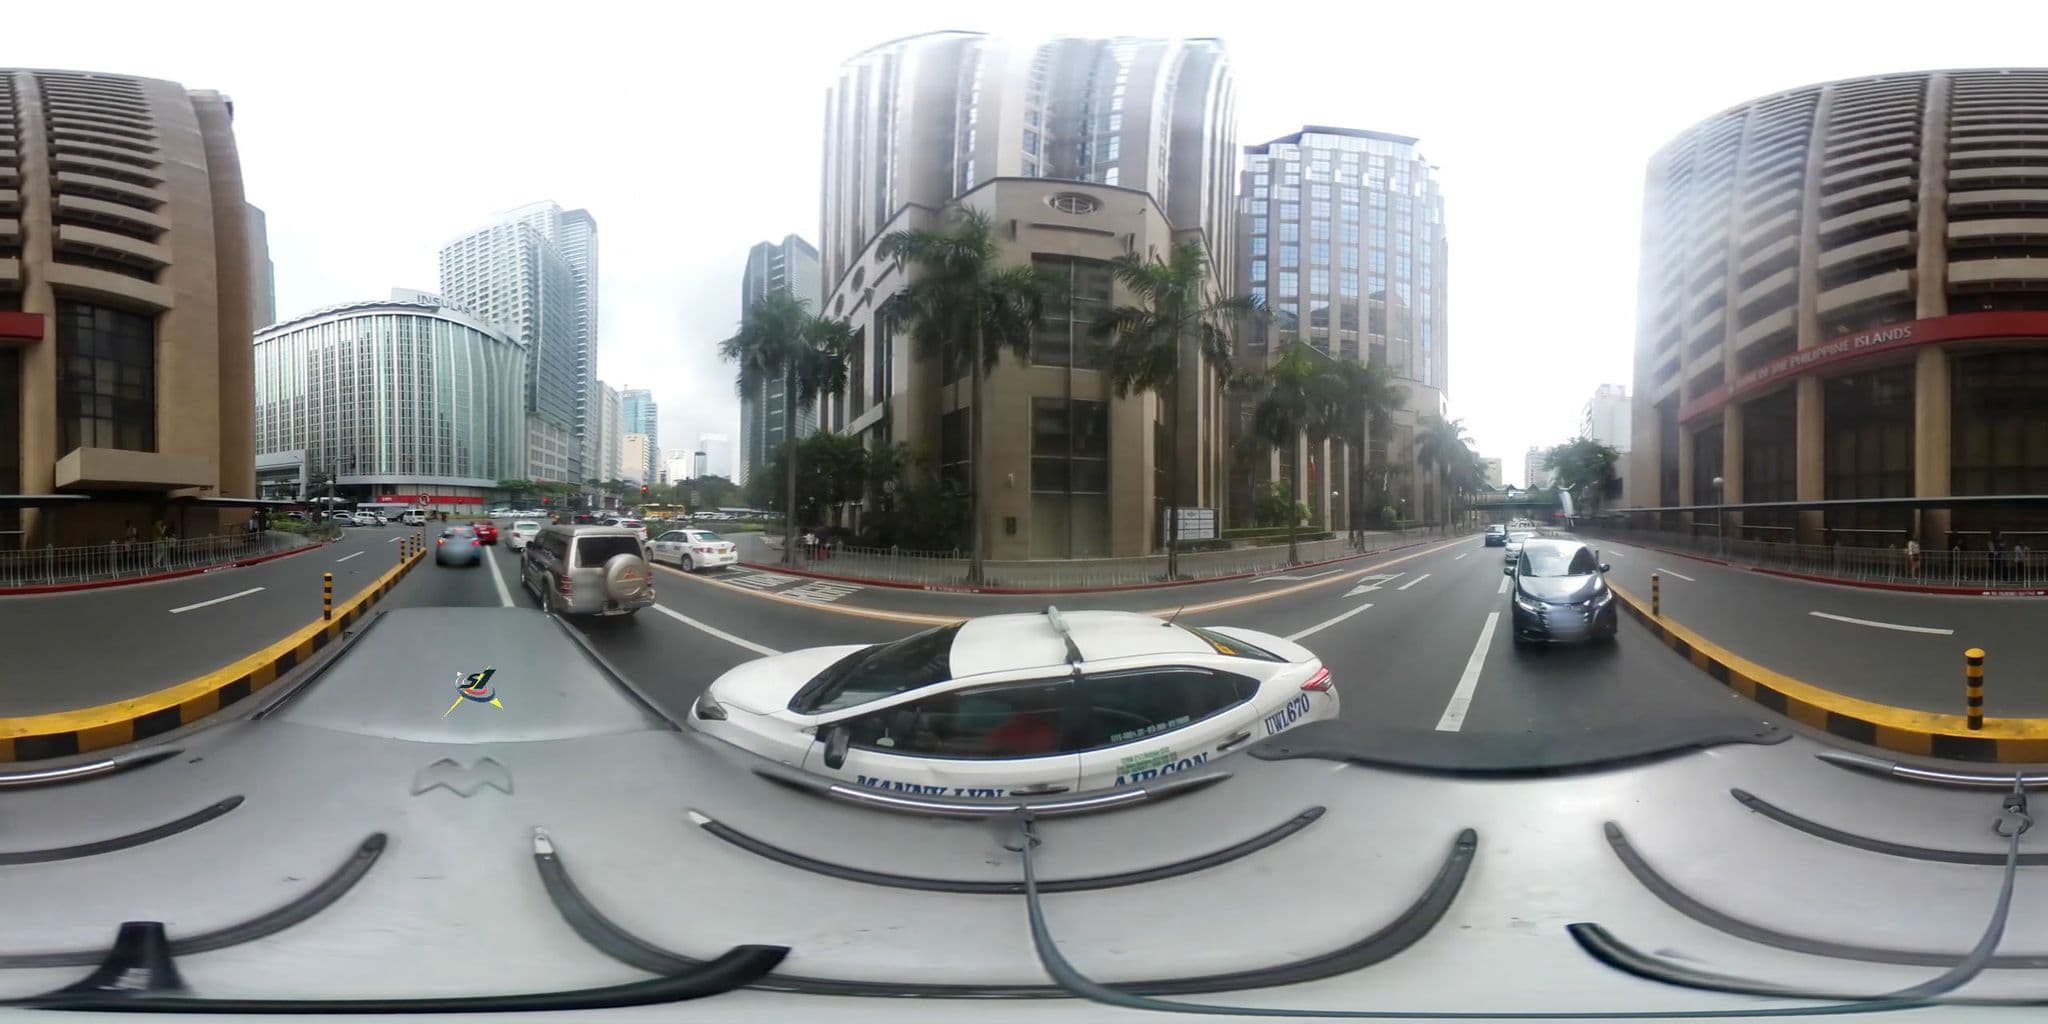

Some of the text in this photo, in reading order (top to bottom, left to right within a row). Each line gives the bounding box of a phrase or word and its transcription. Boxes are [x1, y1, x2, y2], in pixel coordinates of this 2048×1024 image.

[1855, 326, 1912, 347] ISLANDS
[1264, 692, 1311, 736] UWL670
[1114, 751, 1209, 788] AIRCON
